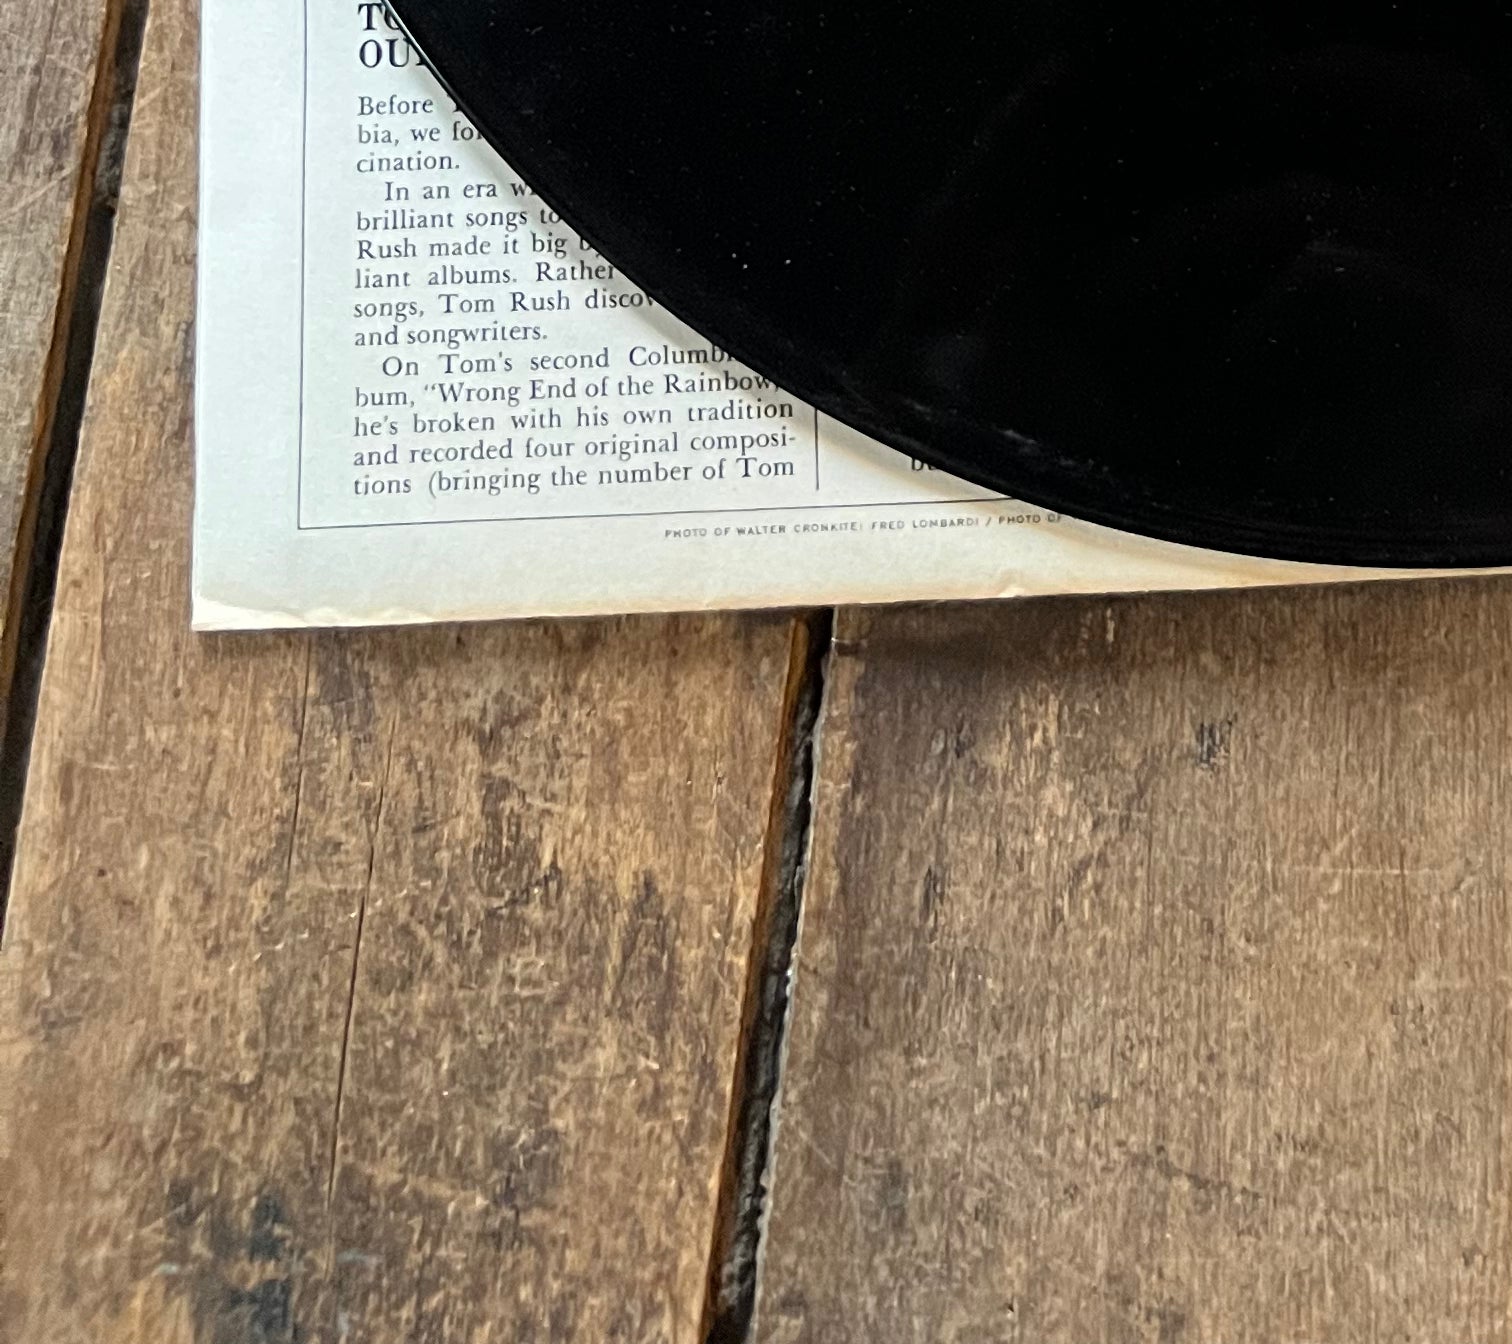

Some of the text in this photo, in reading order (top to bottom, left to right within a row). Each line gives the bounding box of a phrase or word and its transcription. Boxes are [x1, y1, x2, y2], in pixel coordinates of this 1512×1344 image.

[356, 150, 461, 173] cination.
[353, 319, 549, 350] and songwriters.
[381, 343, 734, 378] On Tom's second Columb
[354, 386, 416, 409] bum,
[422, 381, 522, 408] "Wrong
[528, 376, 577, 401] End
[584, 375, 610, 399] of
[617, 374, 655, 397] the
[352, 396, 794, 438] he's broken with his own tradition
[352, 425, 796, 467] and recorded four original composi-
[353, 456, 795, 500] tions (bringing the number of Tom
